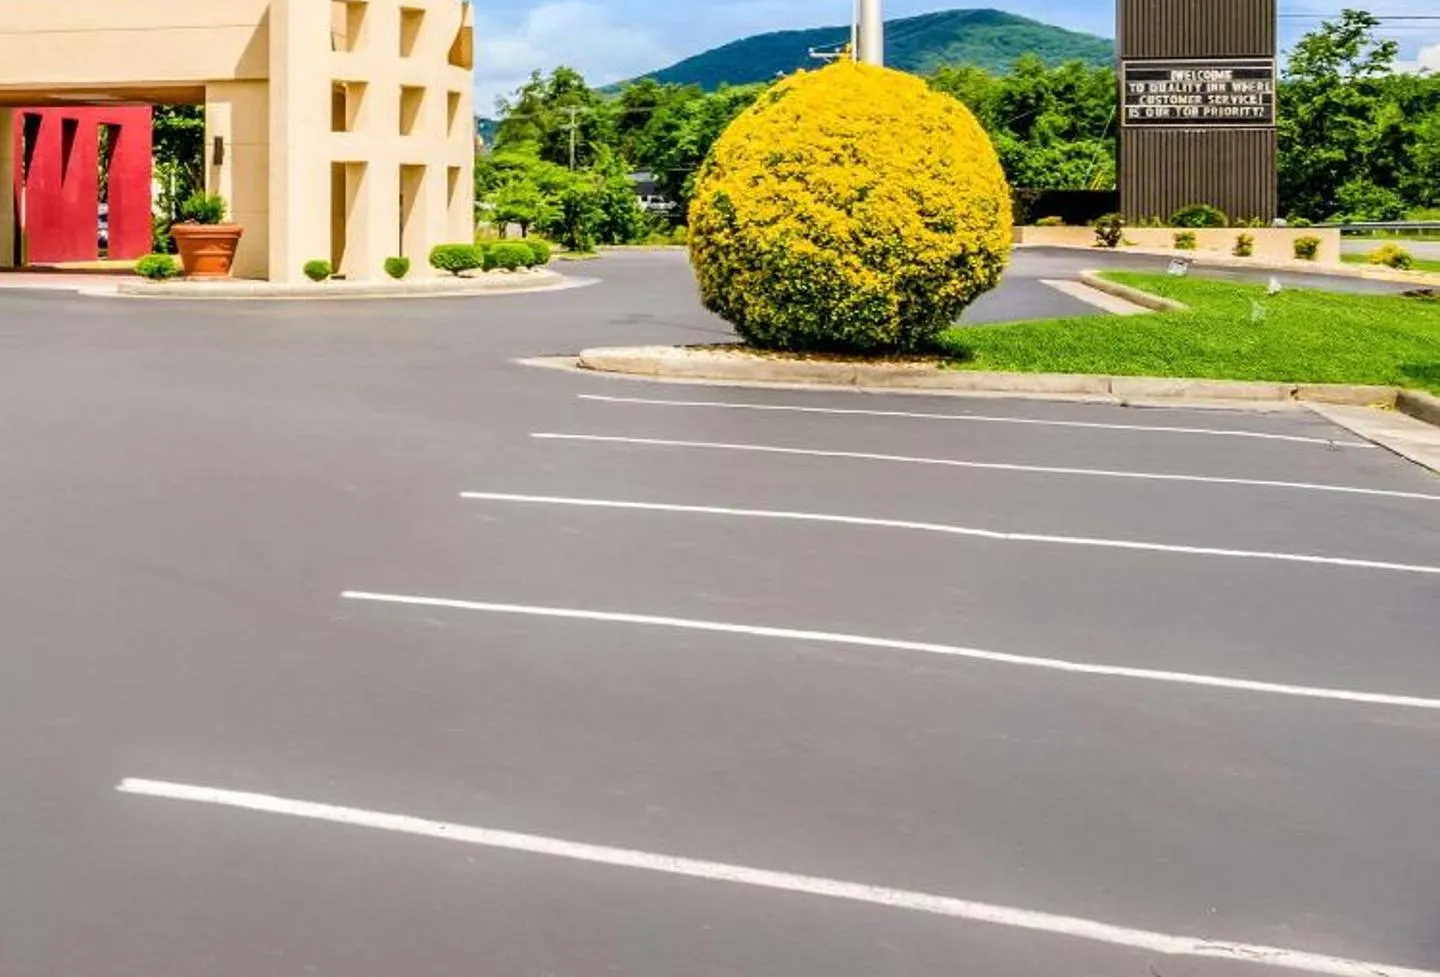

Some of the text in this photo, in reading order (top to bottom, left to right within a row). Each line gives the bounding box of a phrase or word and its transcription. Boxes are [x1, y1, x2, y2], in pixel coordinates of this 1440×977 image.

[1129, 80, 1270, 93] TO QUALITY INN WHERE
[1139, 95, 1202, 105] CUSTOMER
[1146, 107, 1170, 118] OUR
